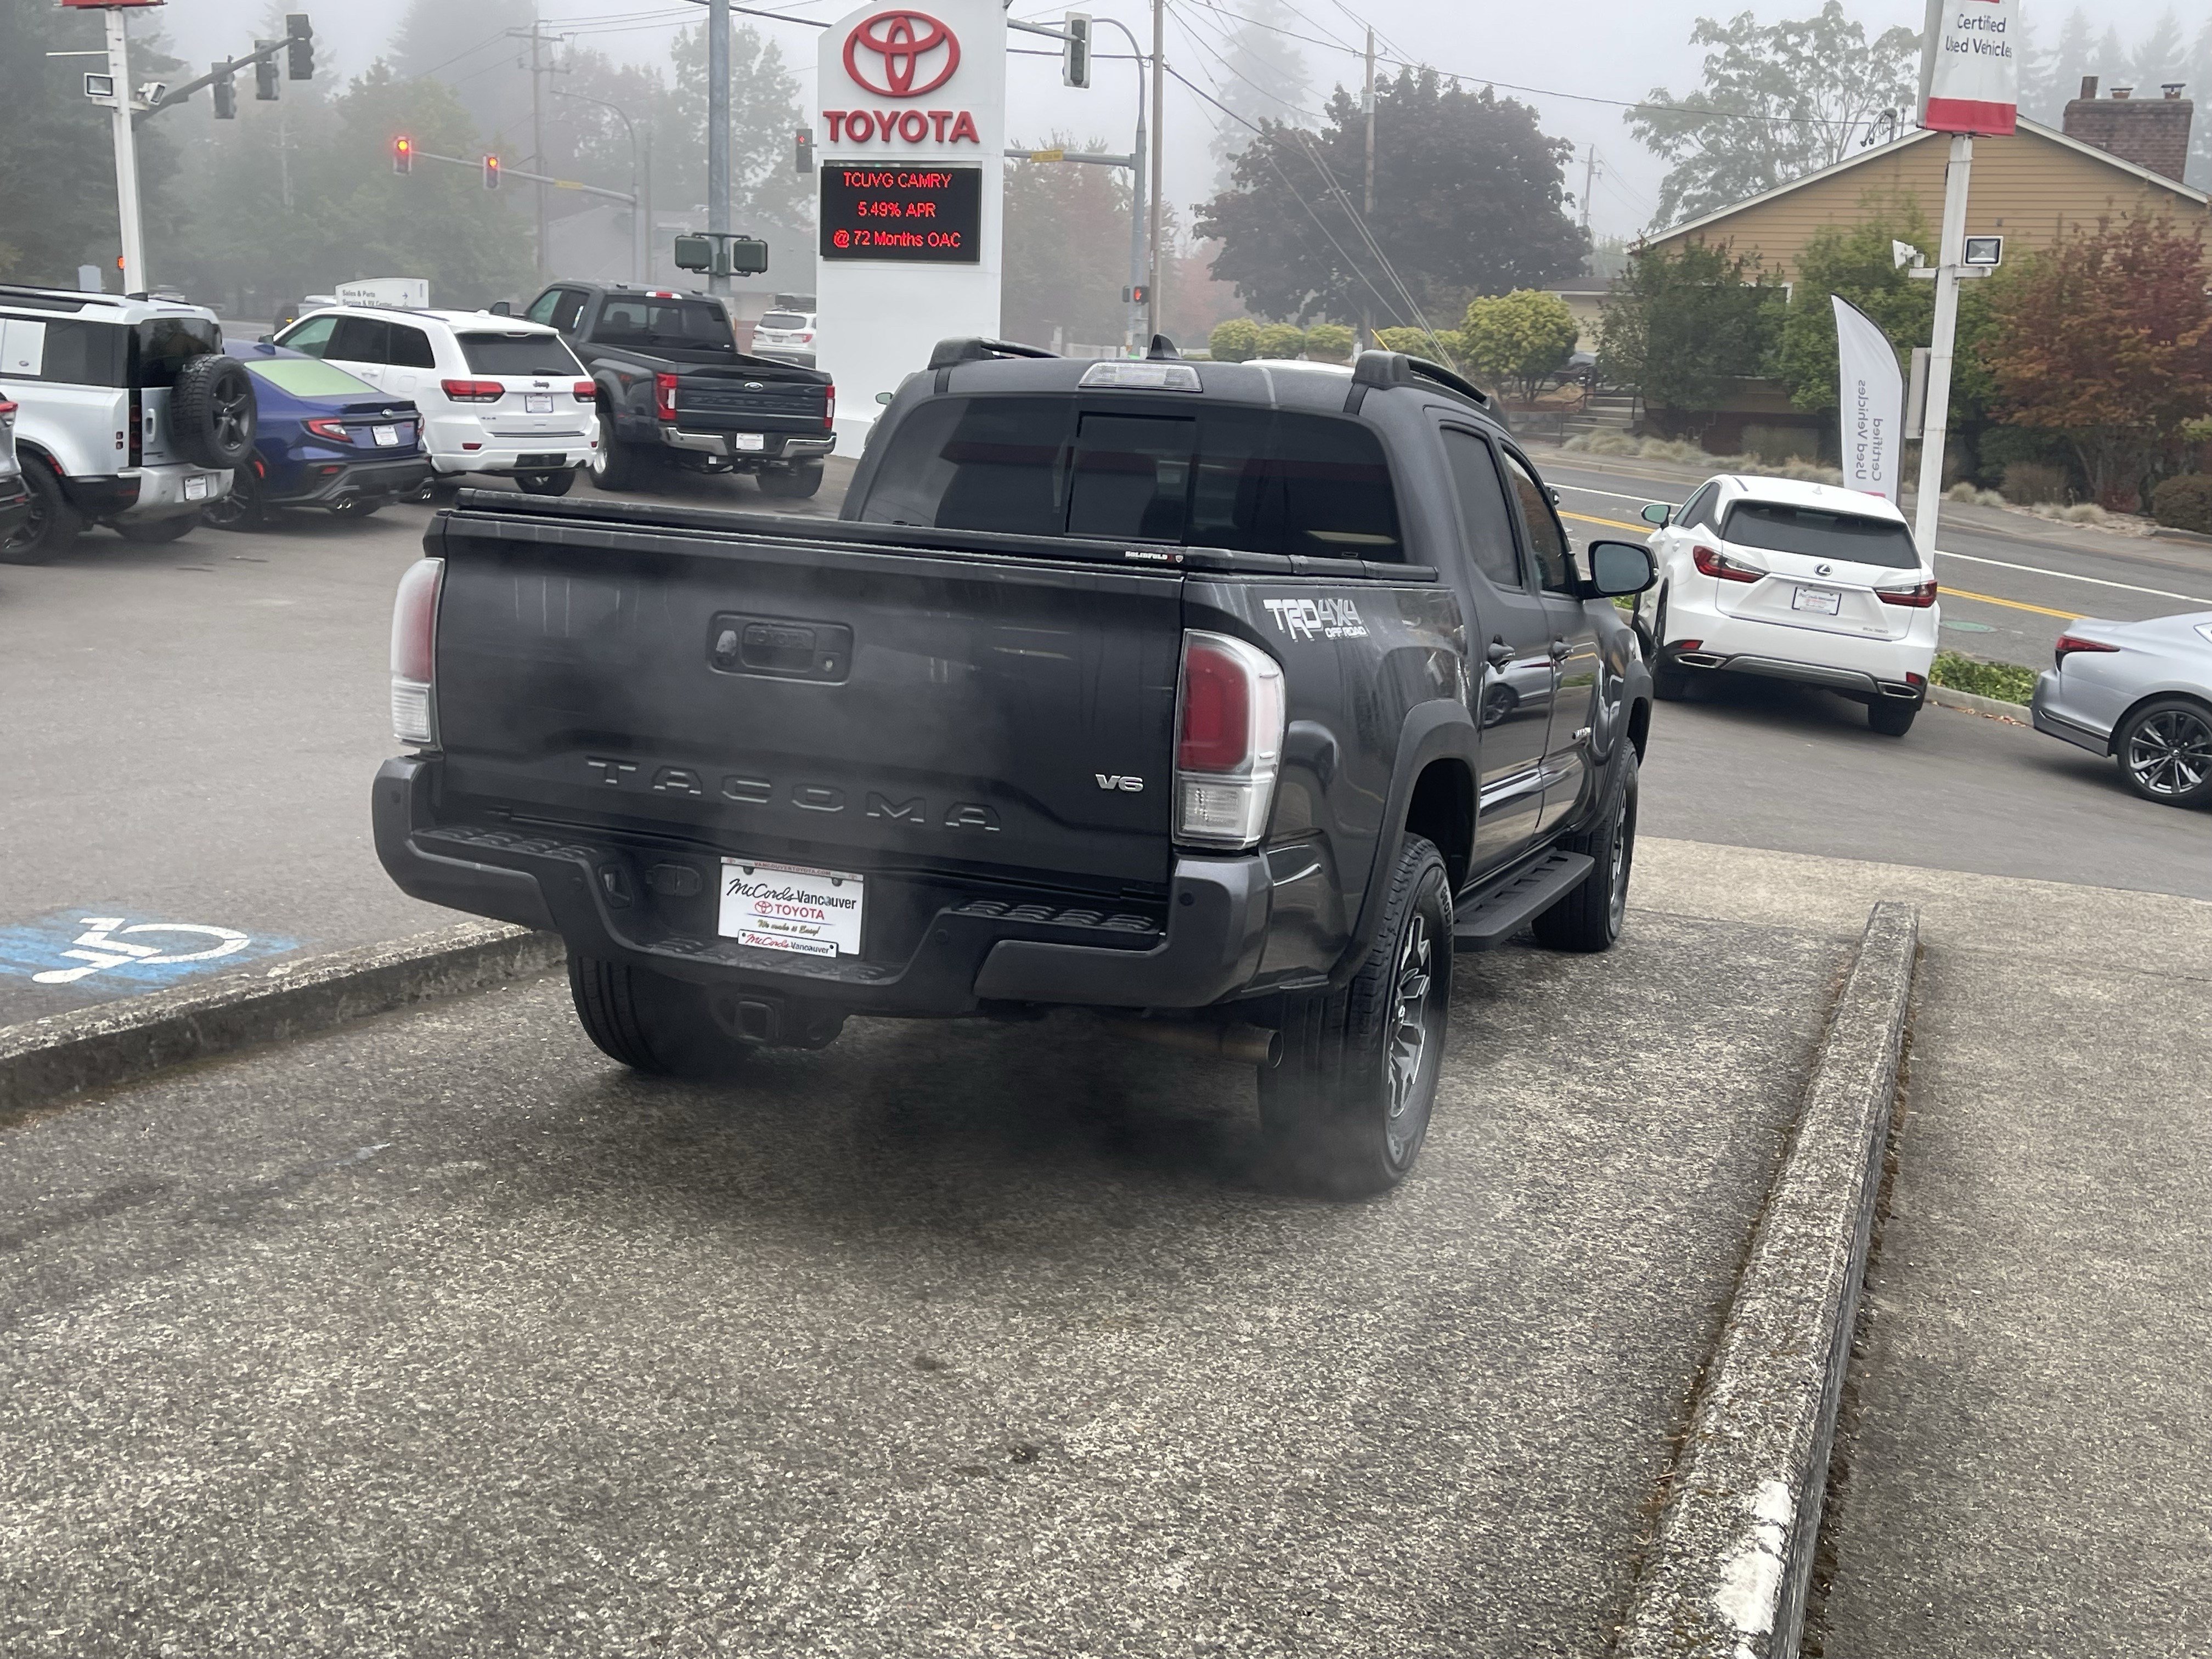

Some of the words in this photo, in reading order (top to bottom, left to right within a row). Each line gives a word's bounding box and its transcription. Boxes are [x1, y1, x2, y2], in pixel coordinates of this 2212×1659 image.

[1957, 13, 2007, 33] Certified
[1945, 35, 1970, 53] Used
[1973, 38, 2013, 59] Vehicles
[823, 110, 980, 144] TOYOTA
[898, 172, 953, 189] CAMRY
[857, 201, 901, 218] 5.49%
[906, 202, 936, 218] APR
[833, 229, 850, 249] @
[853, 230, 871, 246] 72
[874, 229, 923, 247] Months
[928, 232, 961, 247] OAC
[1263, 599, 1325, 641] TRD
[1324, 627, 1342, 639] OFF
[1342, 626, 1368, 637] ROAD
[1095, 774, 1144, 792] V6
[585, 755, 1001, 832] TACOMA
[775, 903, 825, 920] TOYOTA
